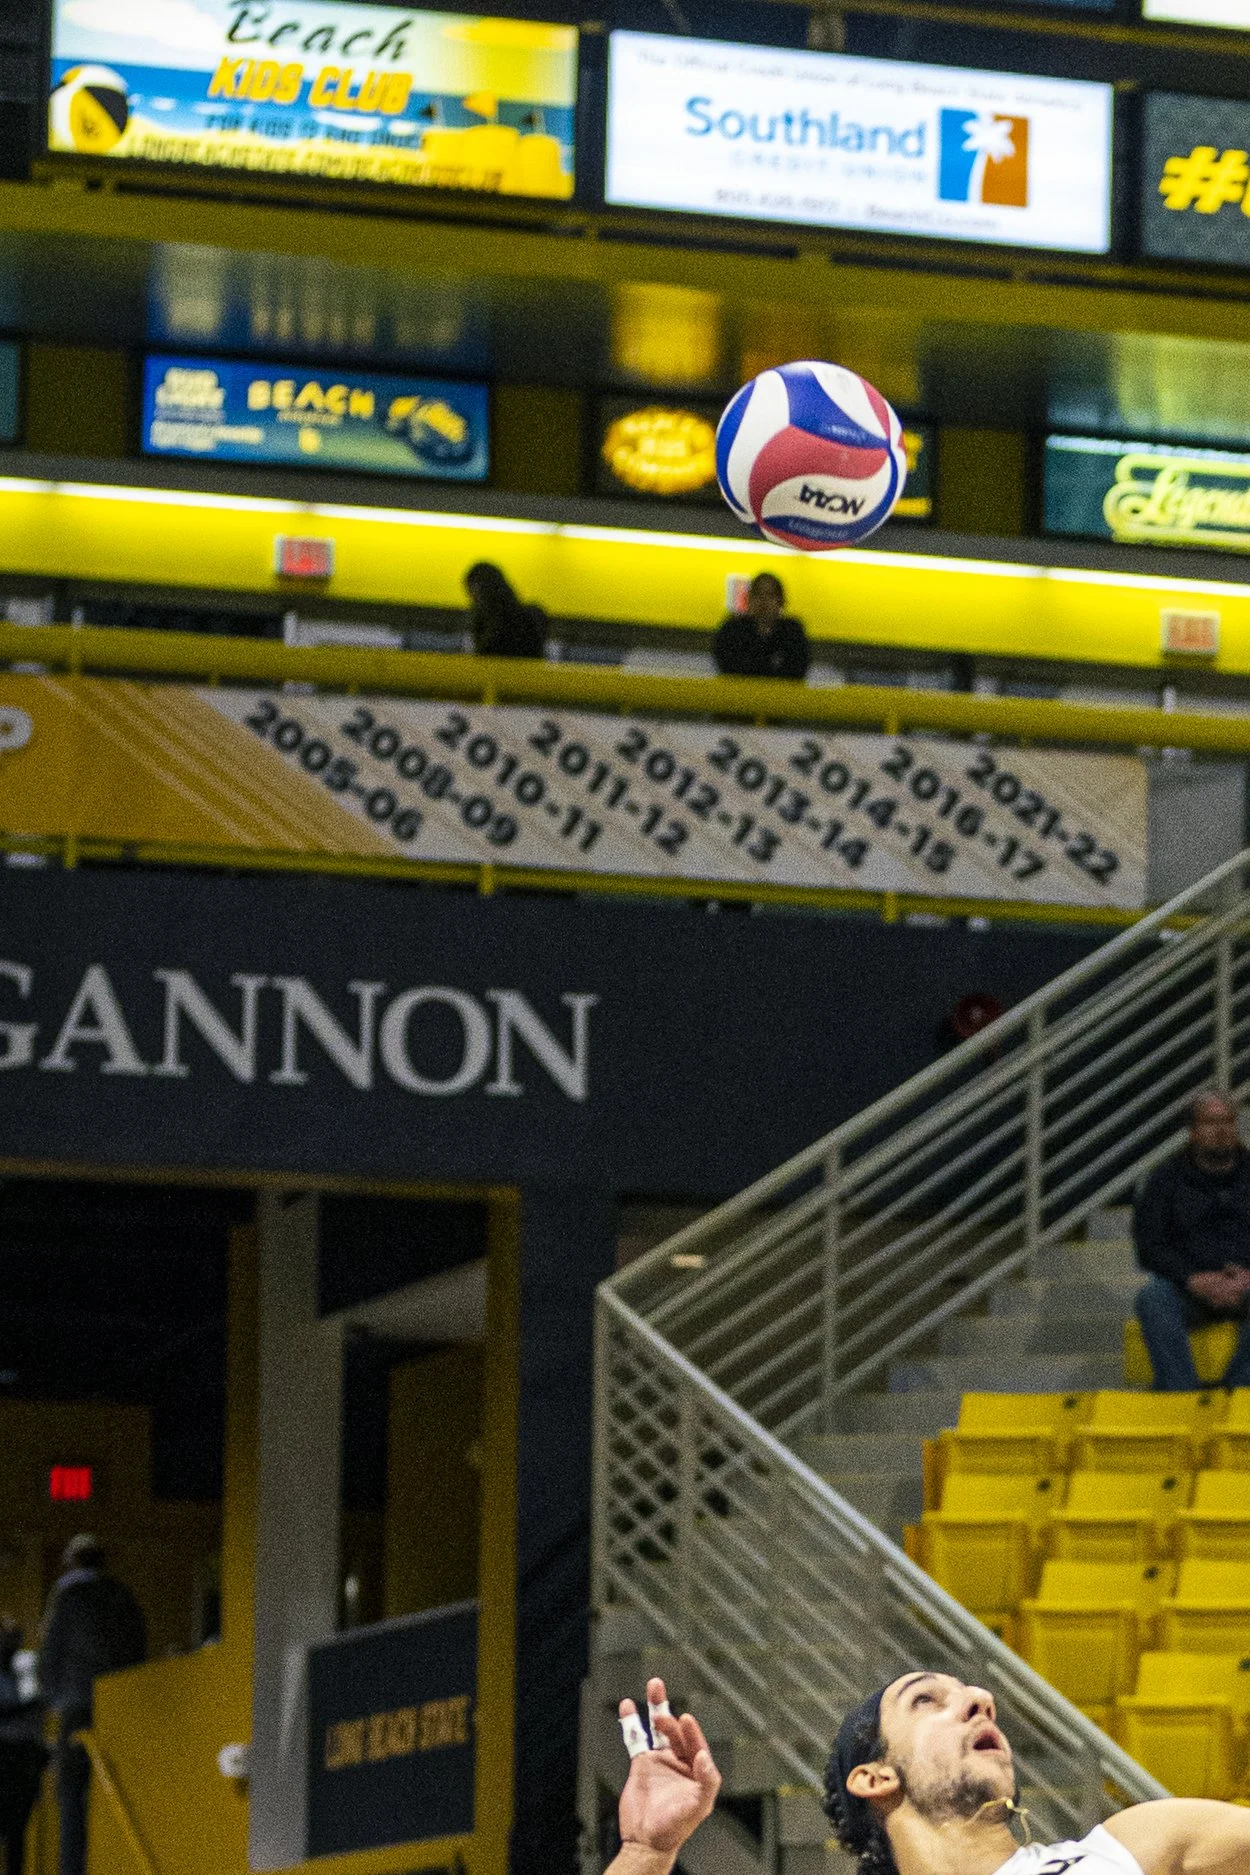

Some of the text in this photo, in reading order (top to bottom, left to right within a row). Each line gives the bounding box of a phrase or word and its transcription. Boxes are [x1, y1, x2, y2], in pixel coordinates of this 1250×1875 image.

[207, 56, 414, 115] KIDS CLUB
[225, 0, 414, 60] Beach
[685, 95, 928, 159] Southland
[800, 484, 865, 516] NCAA
[244, 700, 425, 845] 2005-06
[340, 707, 521, 849] 2008-09
[433, 712, 605, 854] 2010-11
[527, 720, 692, 858] 2011-12
[615, 727, 783, 864] 2012-13
[707, 737, 872, 870] 2013-14
[965, 751, 1121, 886] 2021-22
